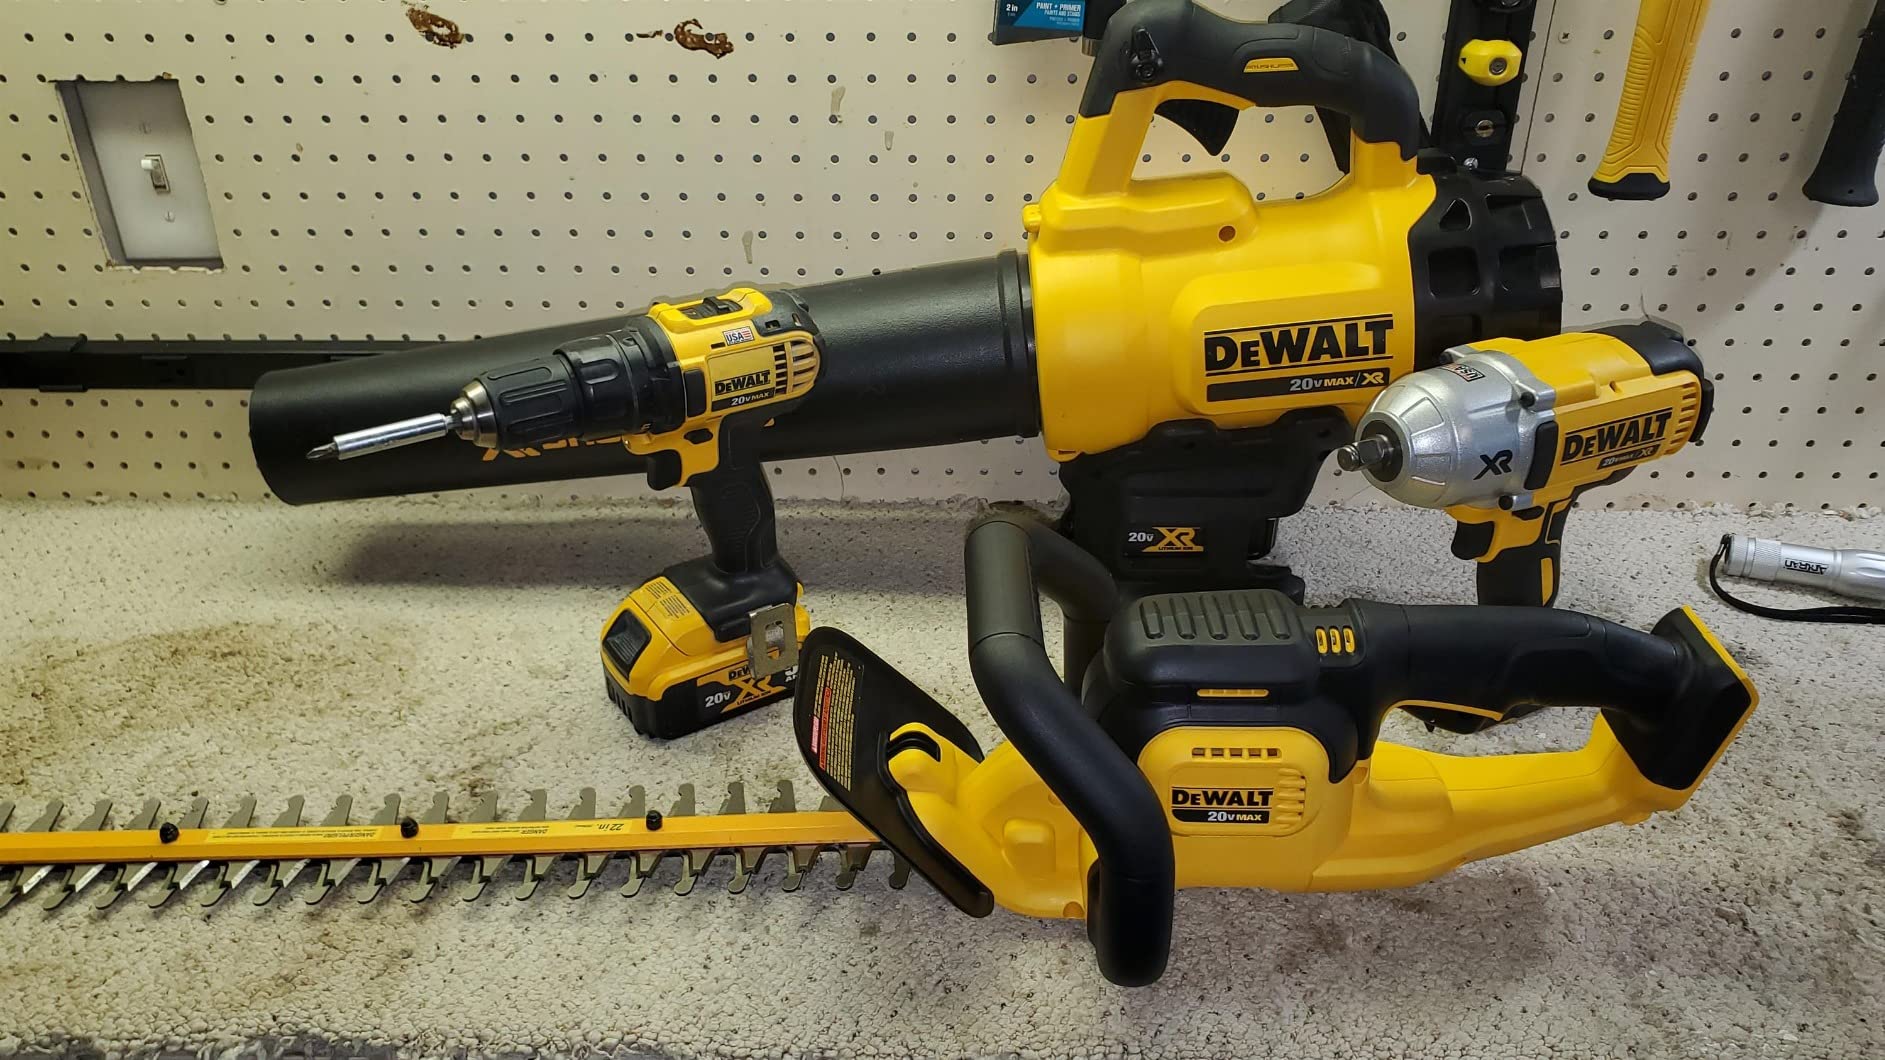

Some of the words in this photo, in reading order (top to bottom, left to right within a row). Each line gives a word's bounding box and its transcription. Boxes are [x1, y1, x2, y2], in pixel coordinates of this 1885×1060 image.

[1012, 4, 1018, 12] in
[1060, 4, 1082, 12] PRIMER
[726, 332, 744, 342] USA
[1204, 319, 1394, 372] DEWALT
[715, 371, 770, 395] DEWALT
[1561, 411, 1673, 462] DEWALT
[1472, 449, 1513, 481] XR
[1152, 526, 1198, 547] XR
[1171, 789, 1274, 807] DEWALT
[1236, 813, 1262, 821] MAX
[609, 823, 625, 831] 22
